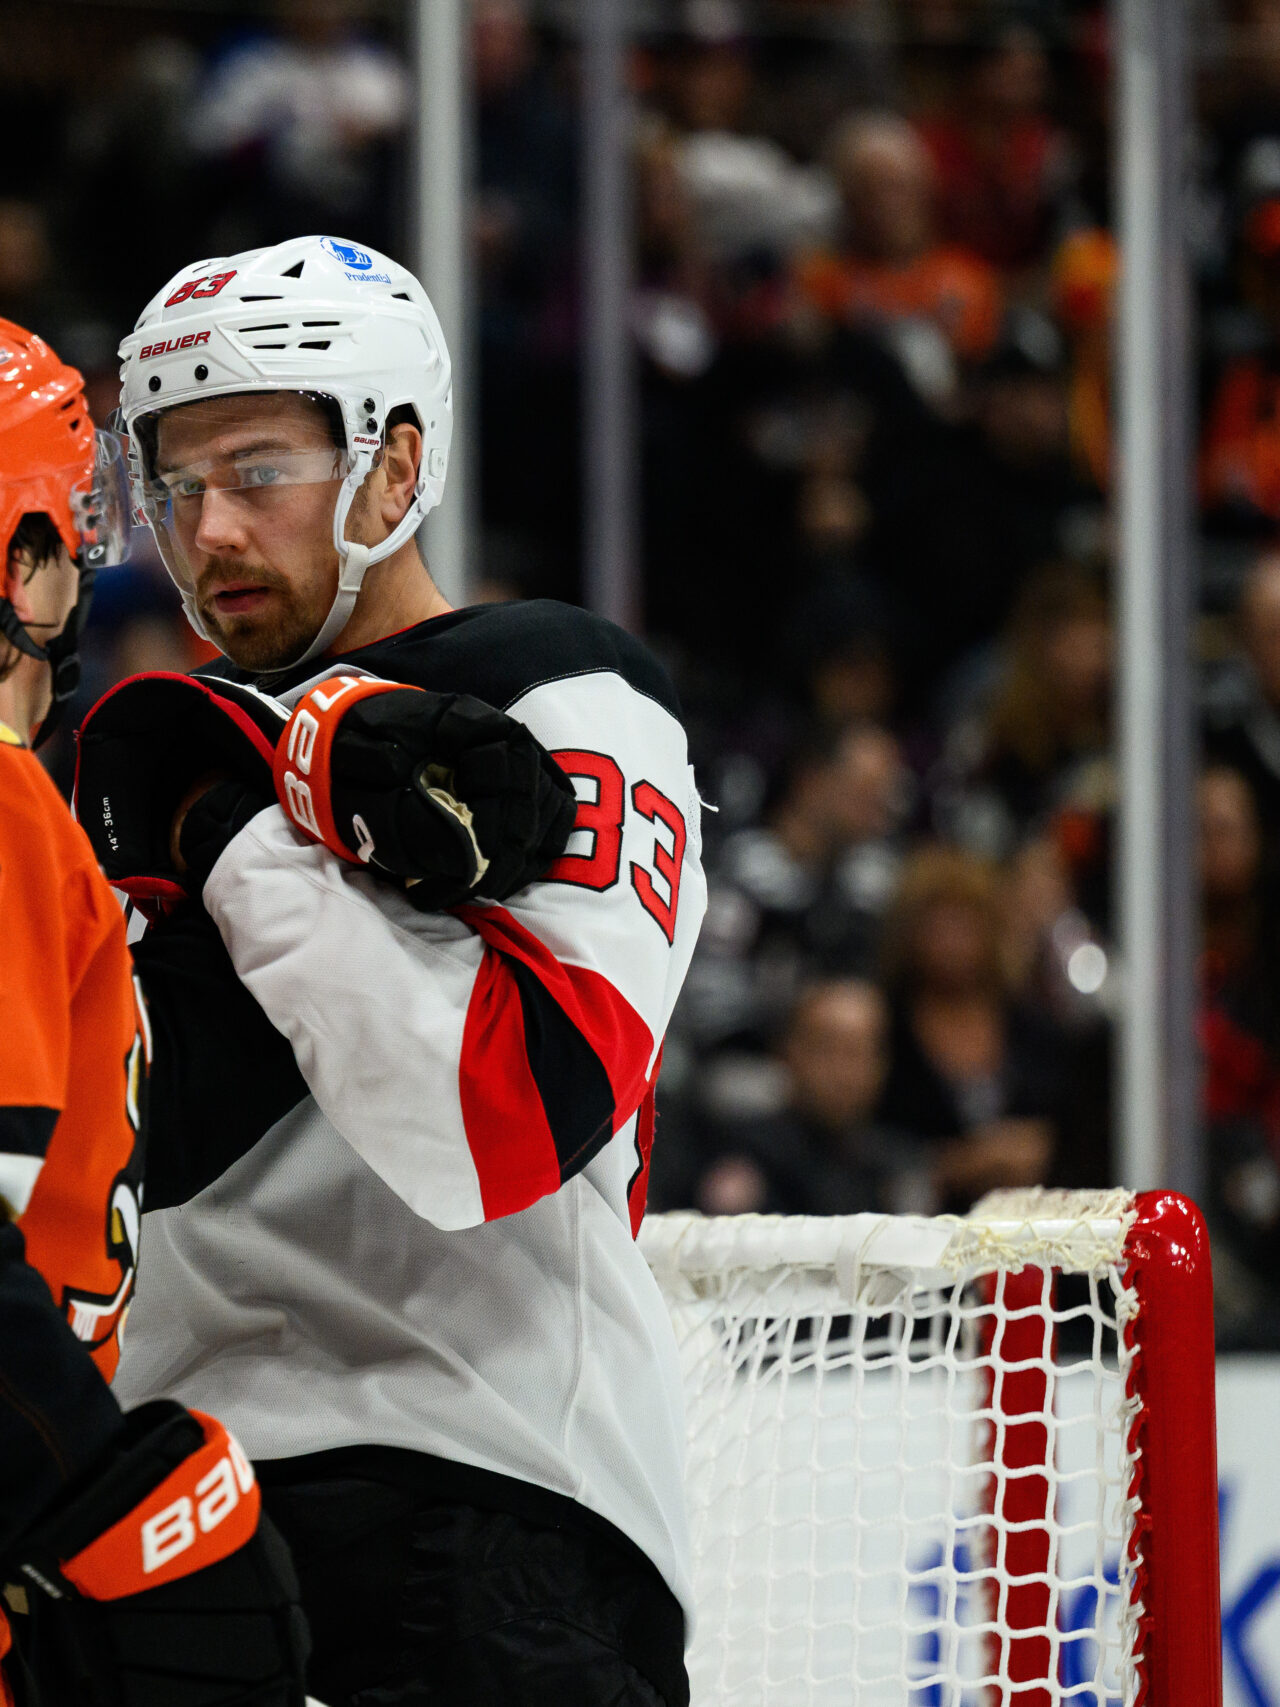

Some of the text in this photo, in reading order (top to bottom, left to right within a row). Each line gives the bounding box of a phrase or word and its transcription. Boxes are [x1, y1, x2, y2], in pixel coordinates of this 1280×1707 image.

[164, 270, 237, 308] 83
[344, 272, 392, 285] Prudential
[139, 330, 211, 360] BAUER
[102, 797, 114, 827] 36cm
[541, 748, 688, 948] 83
